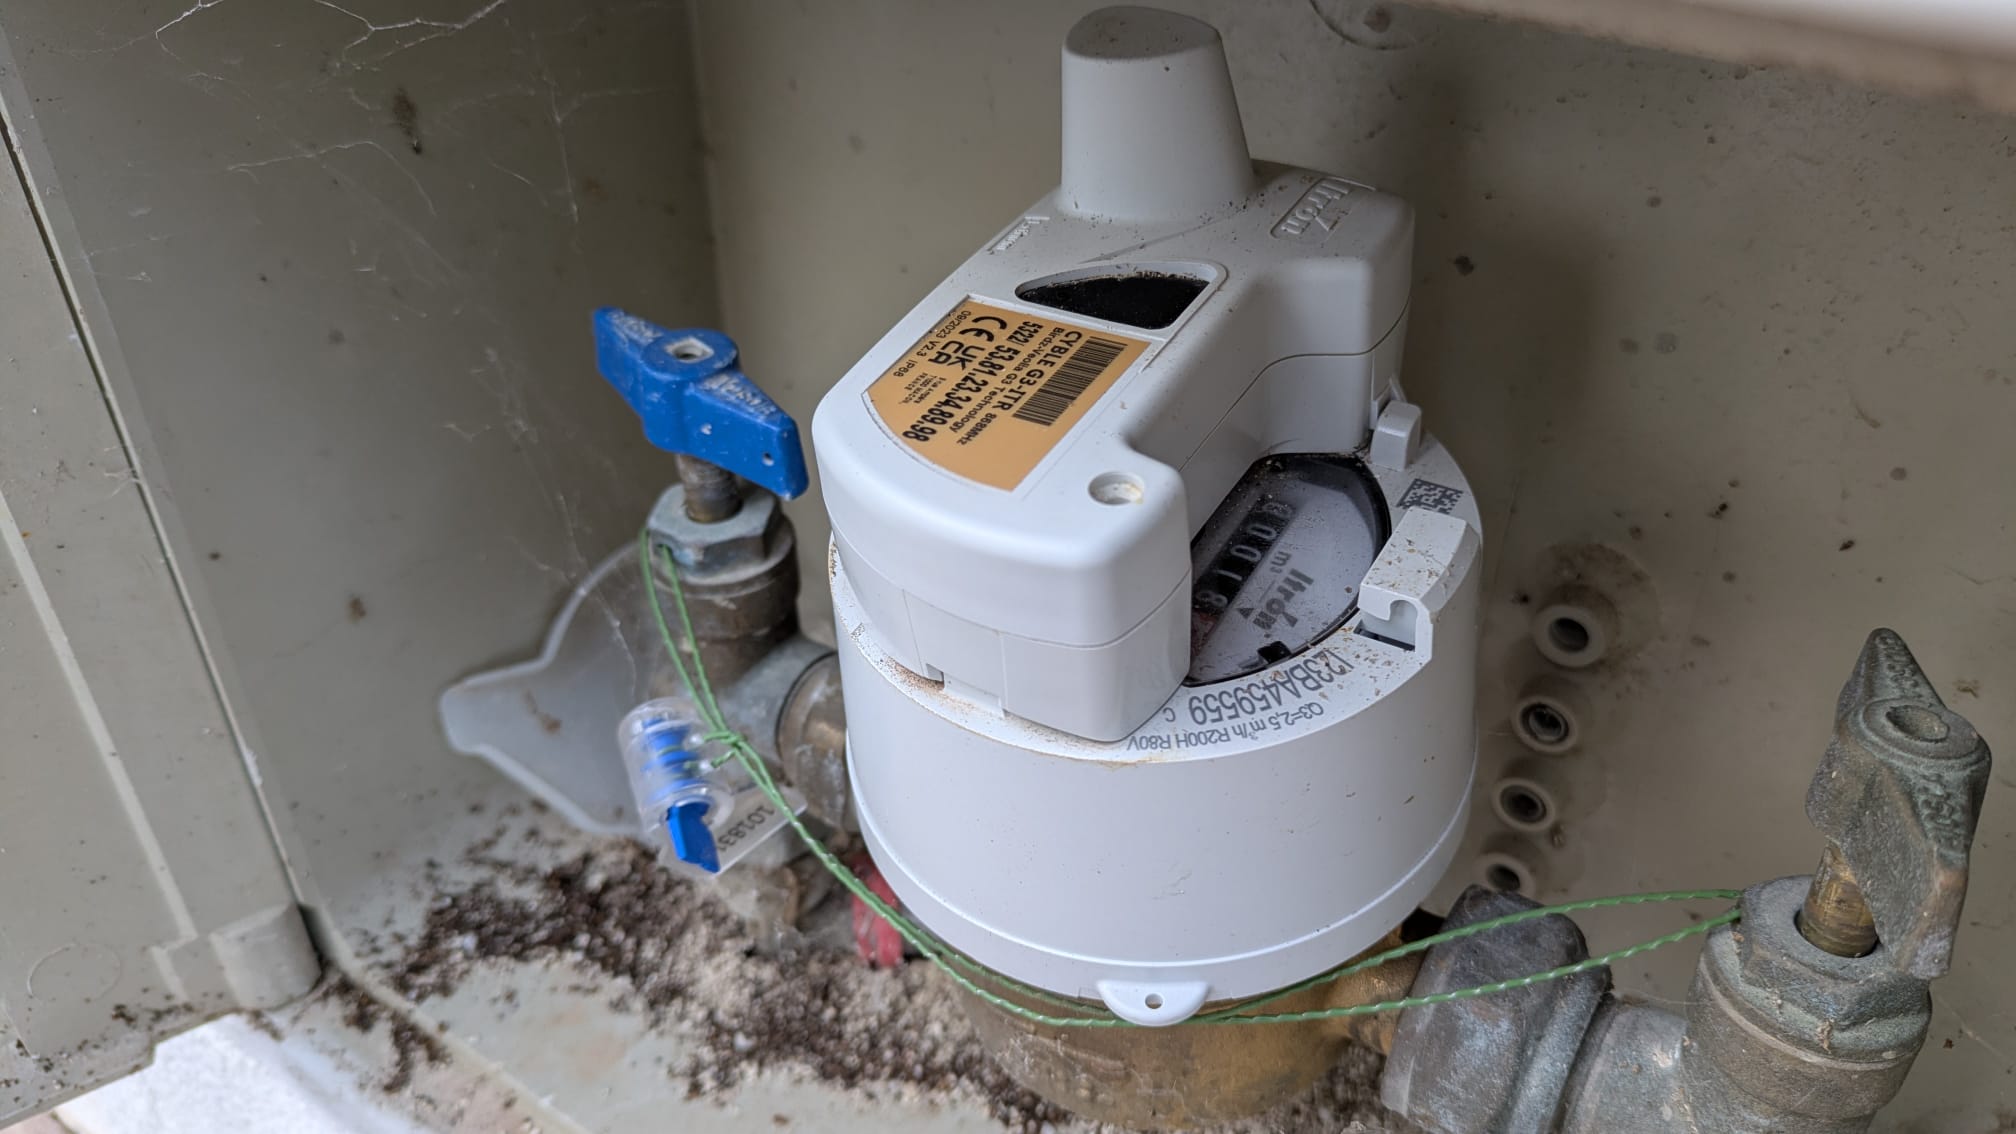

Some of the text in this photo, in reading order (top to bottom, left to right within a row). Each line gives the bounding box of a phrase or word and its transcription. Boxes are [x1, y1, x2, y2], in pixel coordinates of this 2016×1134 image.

[916, 340, 941, 357] V2.3
[928, 340, 965, 365] CA
[947, 345, 986, 371] UK
[1014, 327, 1065, 371] Birdz-Veolia
[893, 359, 918, 377] IP68
[1001, 373, 1018, 385] G3
[902, 345, 1021, 442] 53.81.23.34.89.98
[956, 331, 1082, 445] CYBLE G3-ITR 868MHz
[949, 387, 1006, 432] Technology
[1252, 568, 1314, 628] Itron
[1188, 649, 1354, 725] I23BA459559
[1268, 702, 1324, 731] Q3=2,5
[1126, 734, 1171, 751] R80V
[1176, 727, 1231, 749] R200H
